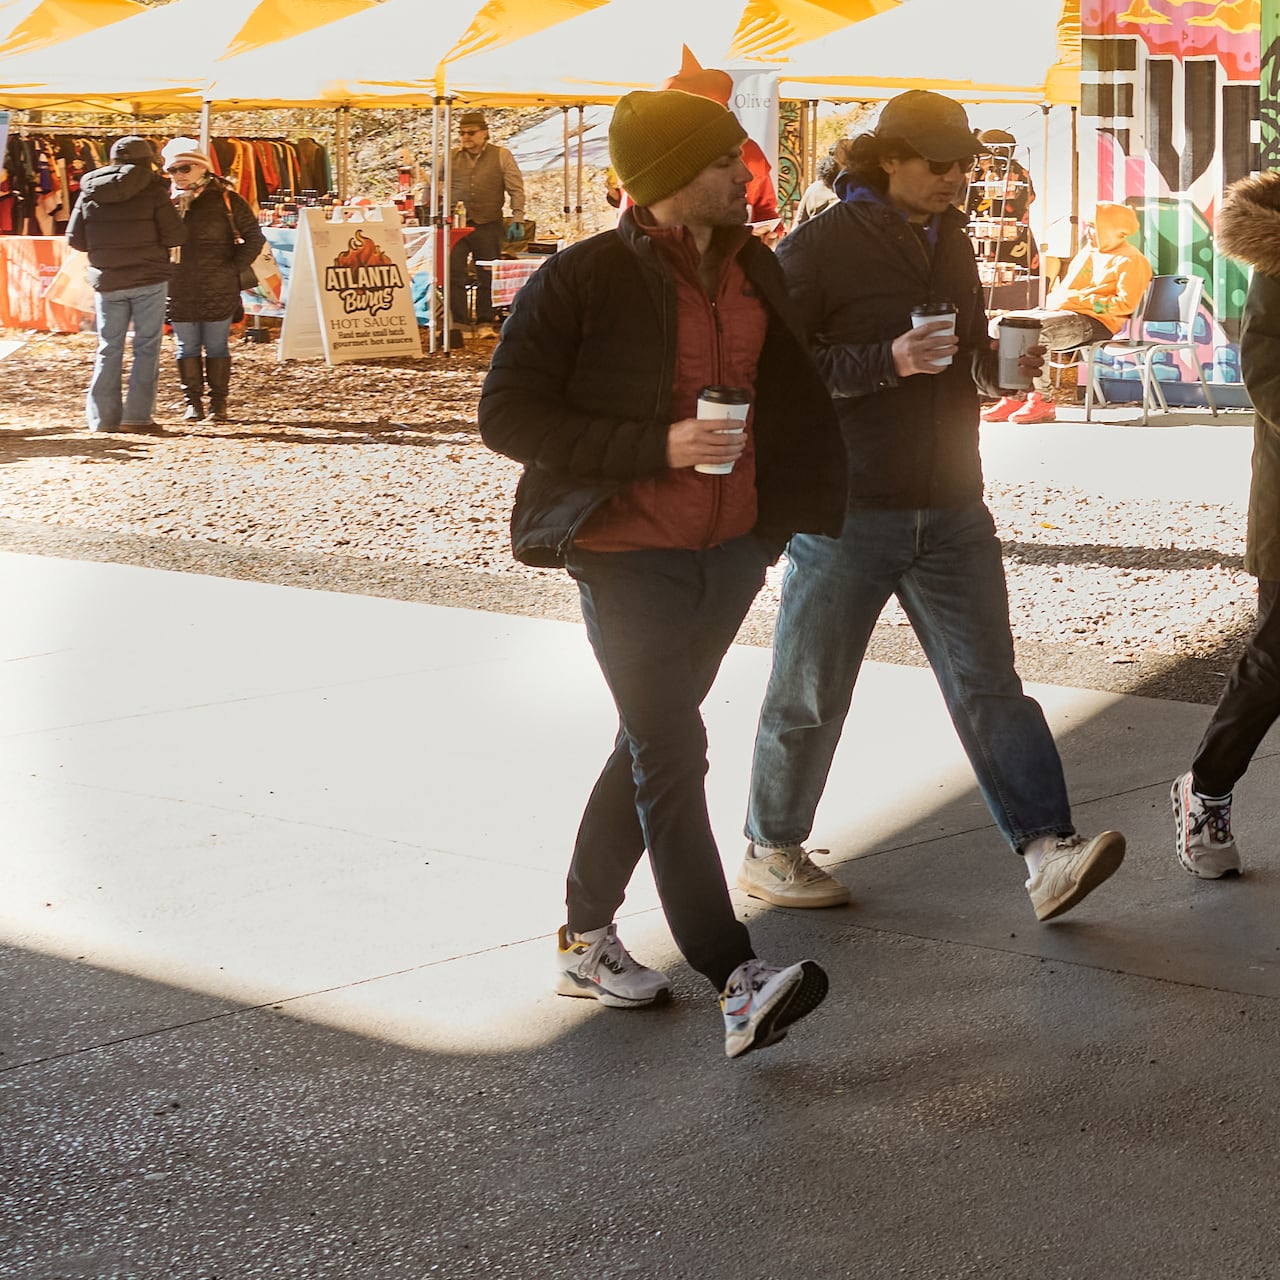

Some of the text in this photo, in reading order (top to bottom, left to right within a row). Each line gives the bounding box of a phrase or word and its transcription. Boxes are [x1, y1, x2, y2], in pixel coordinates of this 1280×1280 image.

[735, 93, 771, 109] Olive
[326, 265, 403, 290] ATLANTA
[340, 288, 393, 316] Burns
[331, 316, 407, 330] HOT SAUCE
[333, 339, 369, 350] gourmet
[386, 337, 413, 345] sauces
